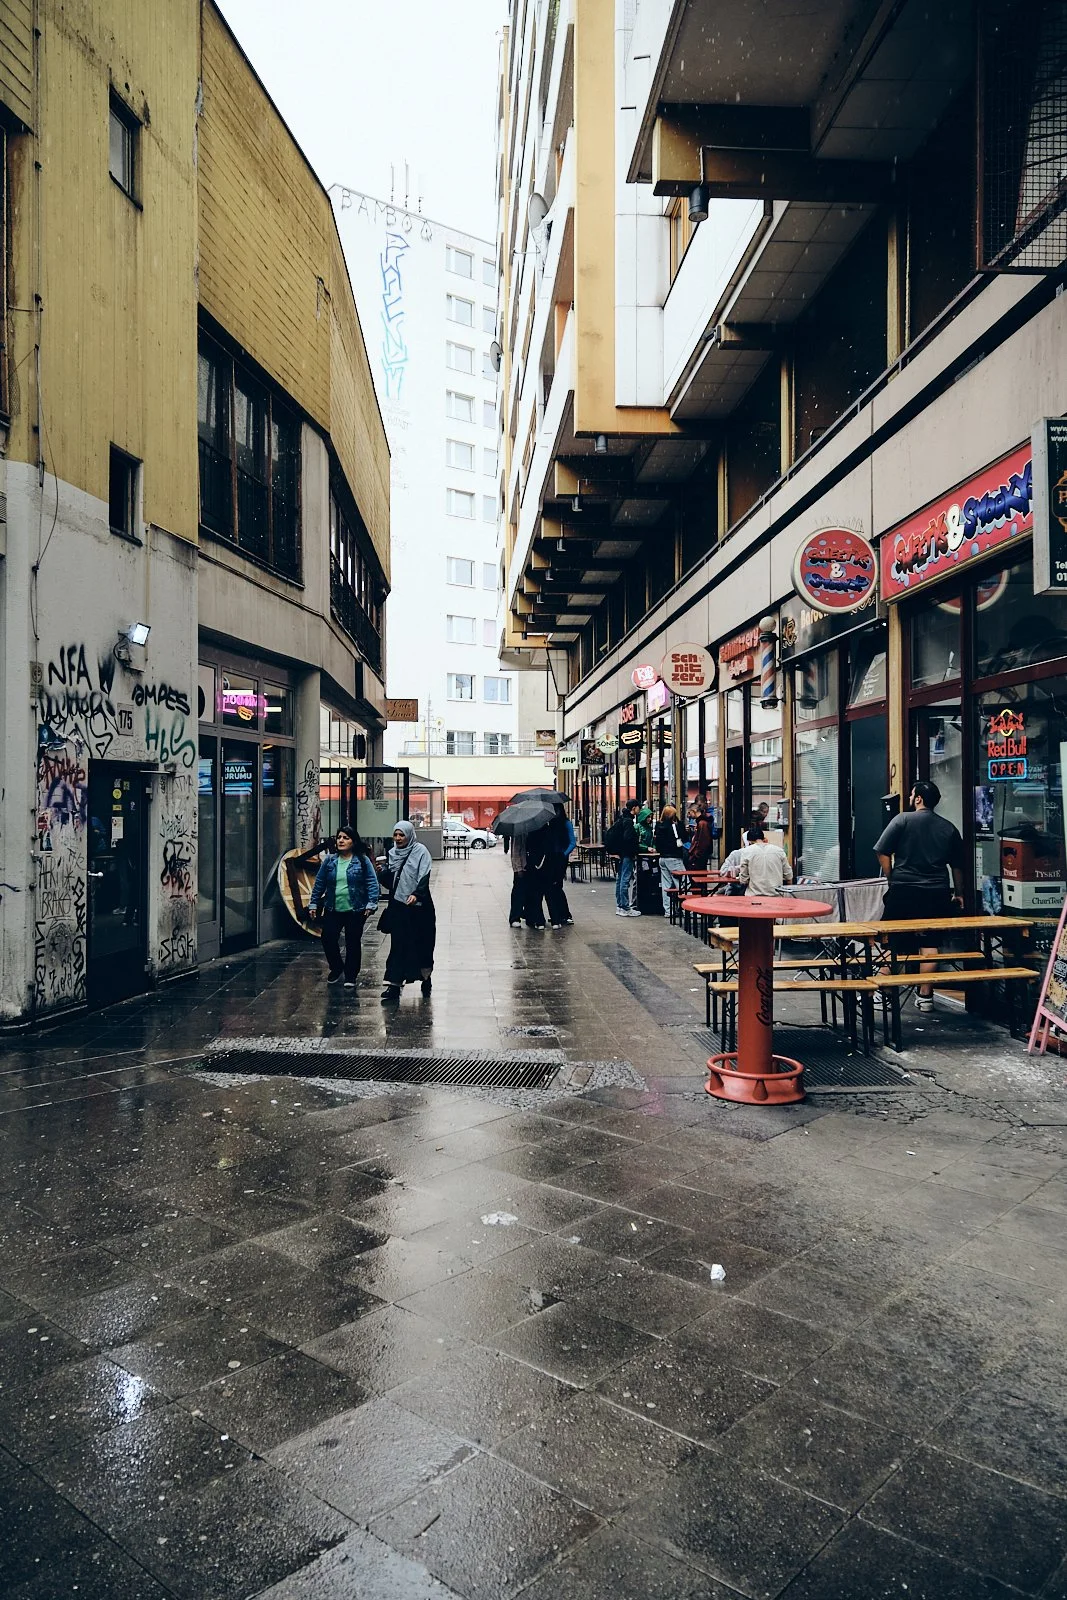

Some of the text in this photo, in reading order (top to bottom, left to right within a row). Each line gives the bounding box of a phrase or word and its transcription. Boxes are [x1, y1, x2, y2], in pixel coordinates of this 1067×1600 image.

[963, 459, 1032, 540] SMOOKY
[118, 709, 133, 730] 175
[988, 735, 1027, 757] Red Bull
[561, 756, 577, 764] flip
[990, 762, 1025, 776] OPEN
[1034, 869, 1061, 878] TYSKIE
